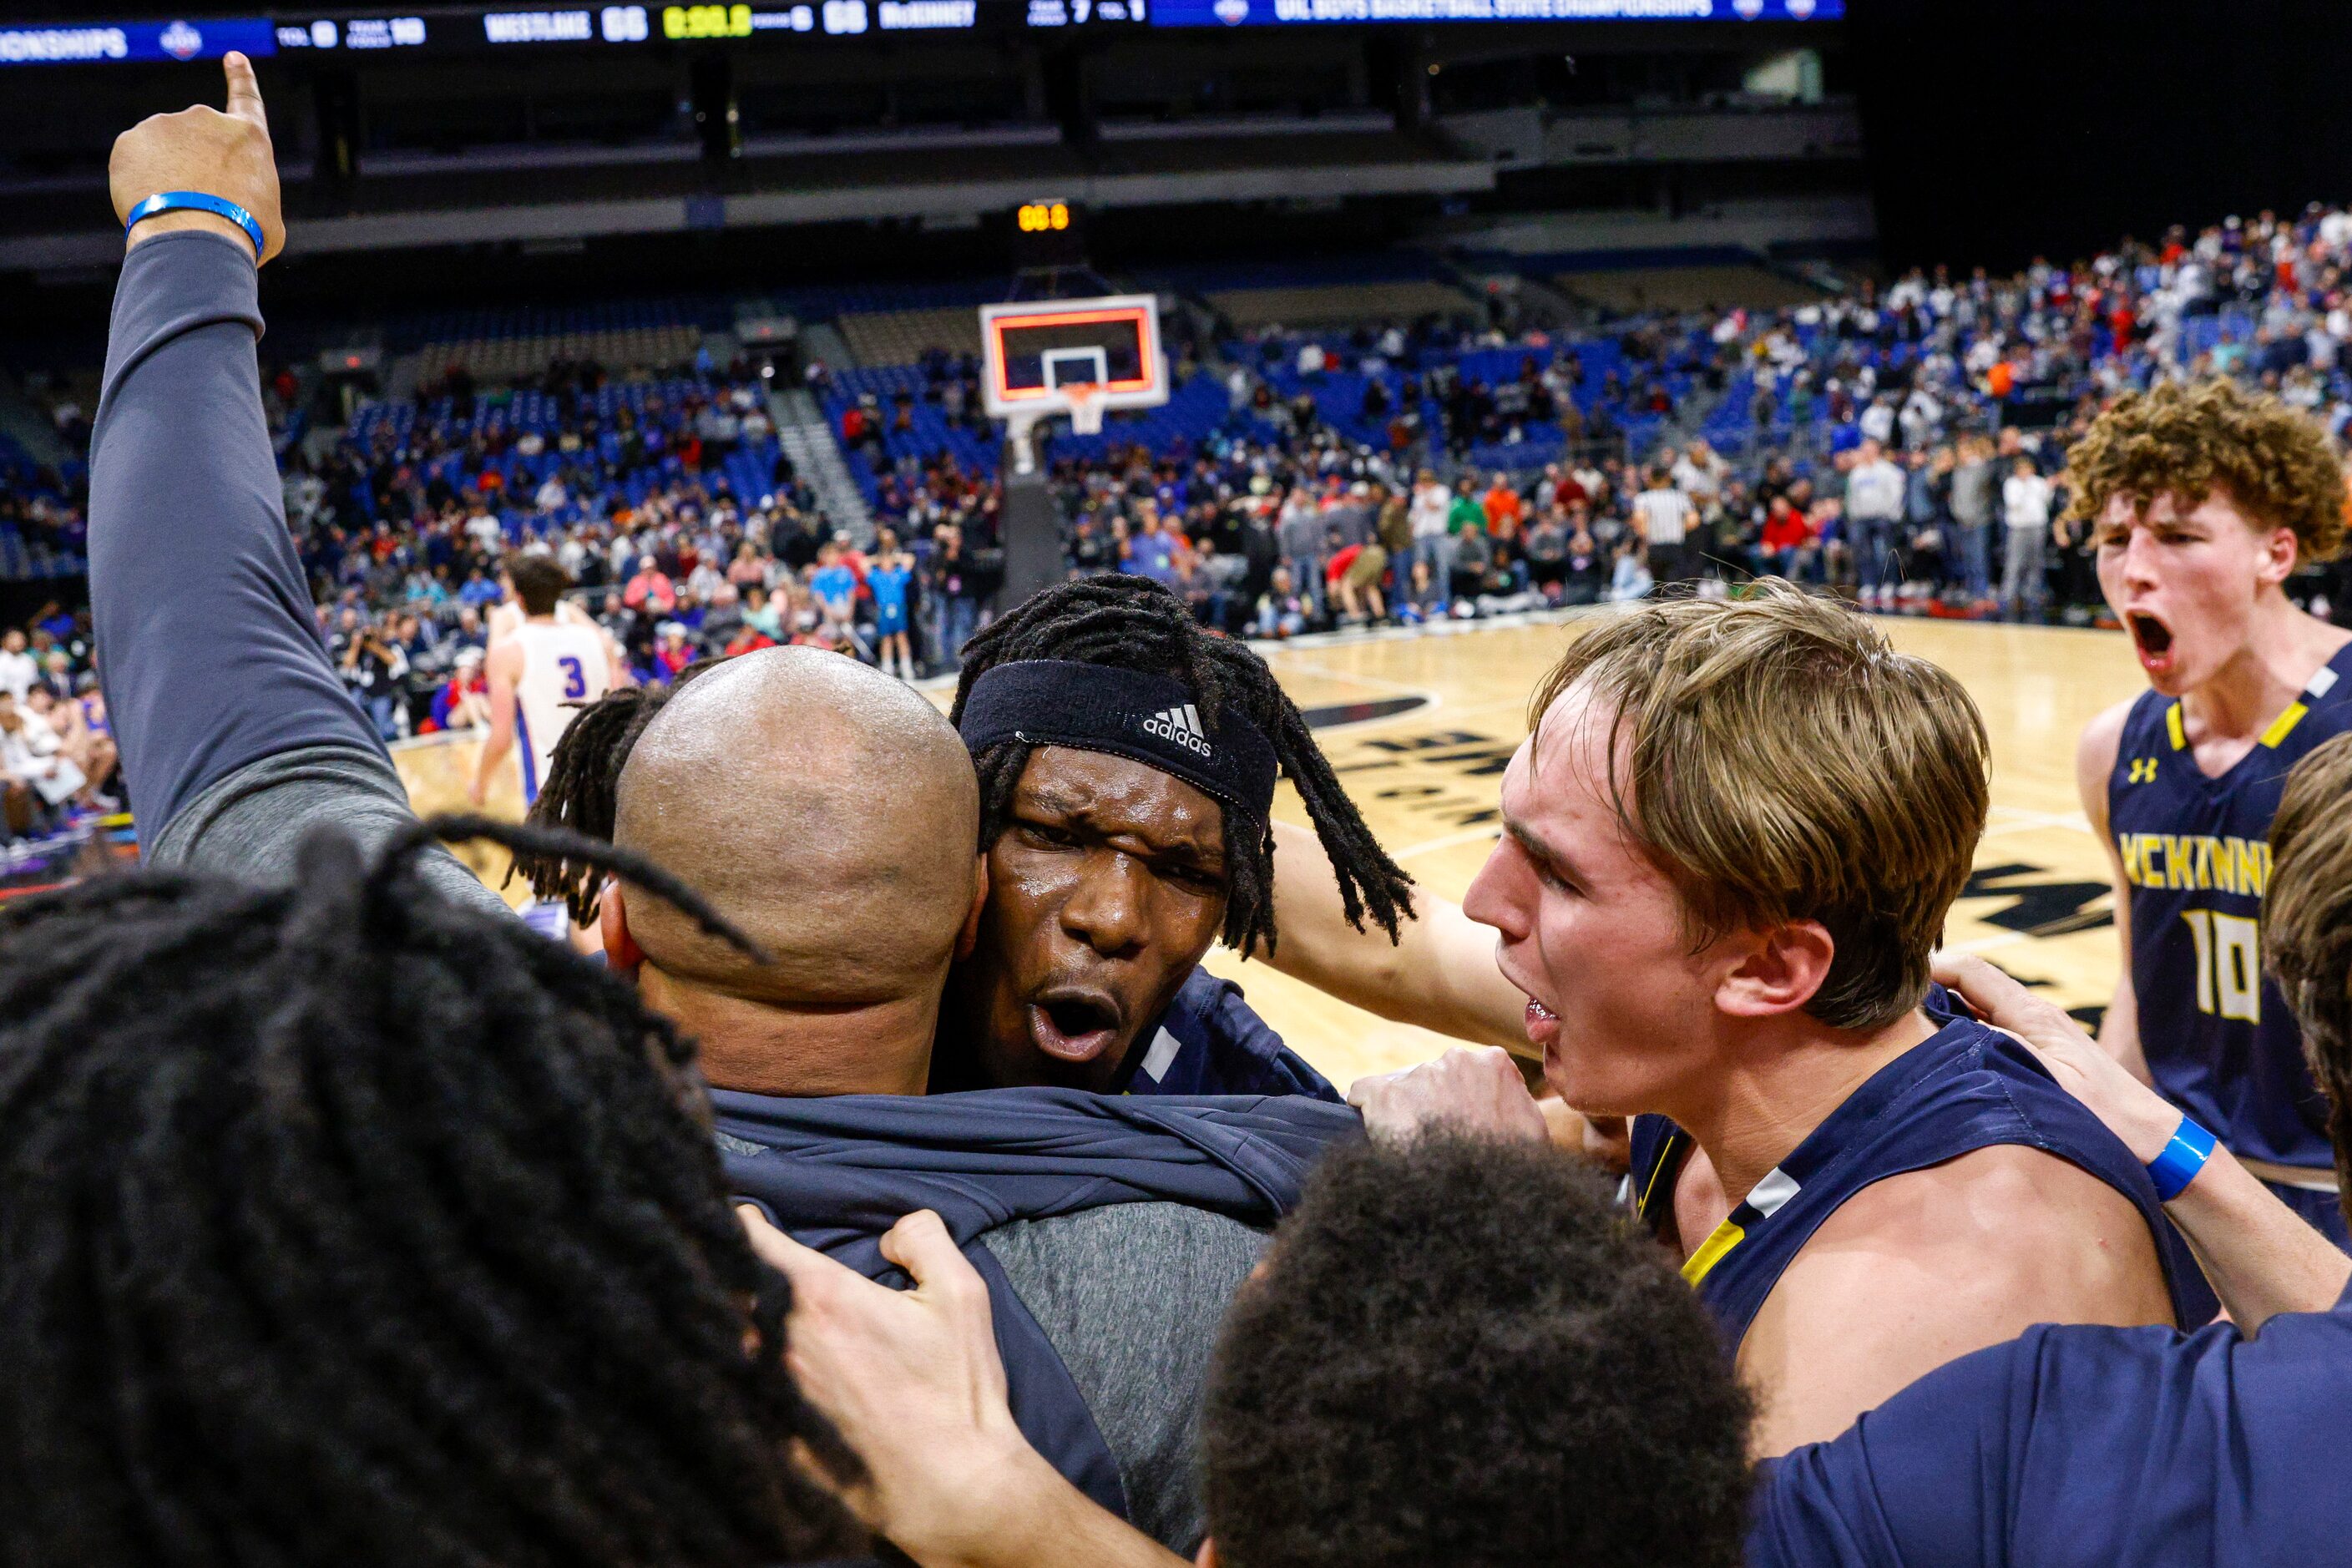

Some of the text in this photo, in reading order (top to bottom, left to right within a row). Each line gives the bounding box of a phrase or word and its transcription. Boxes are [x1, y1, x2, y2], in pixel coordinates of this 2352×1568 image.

[483, 11, 592, 42] WESTLAKE
[559, 656, 585, 698] 3
[1143, 718, 1211, 757] adidas
[2180, 908, 2261, 1025] 10
